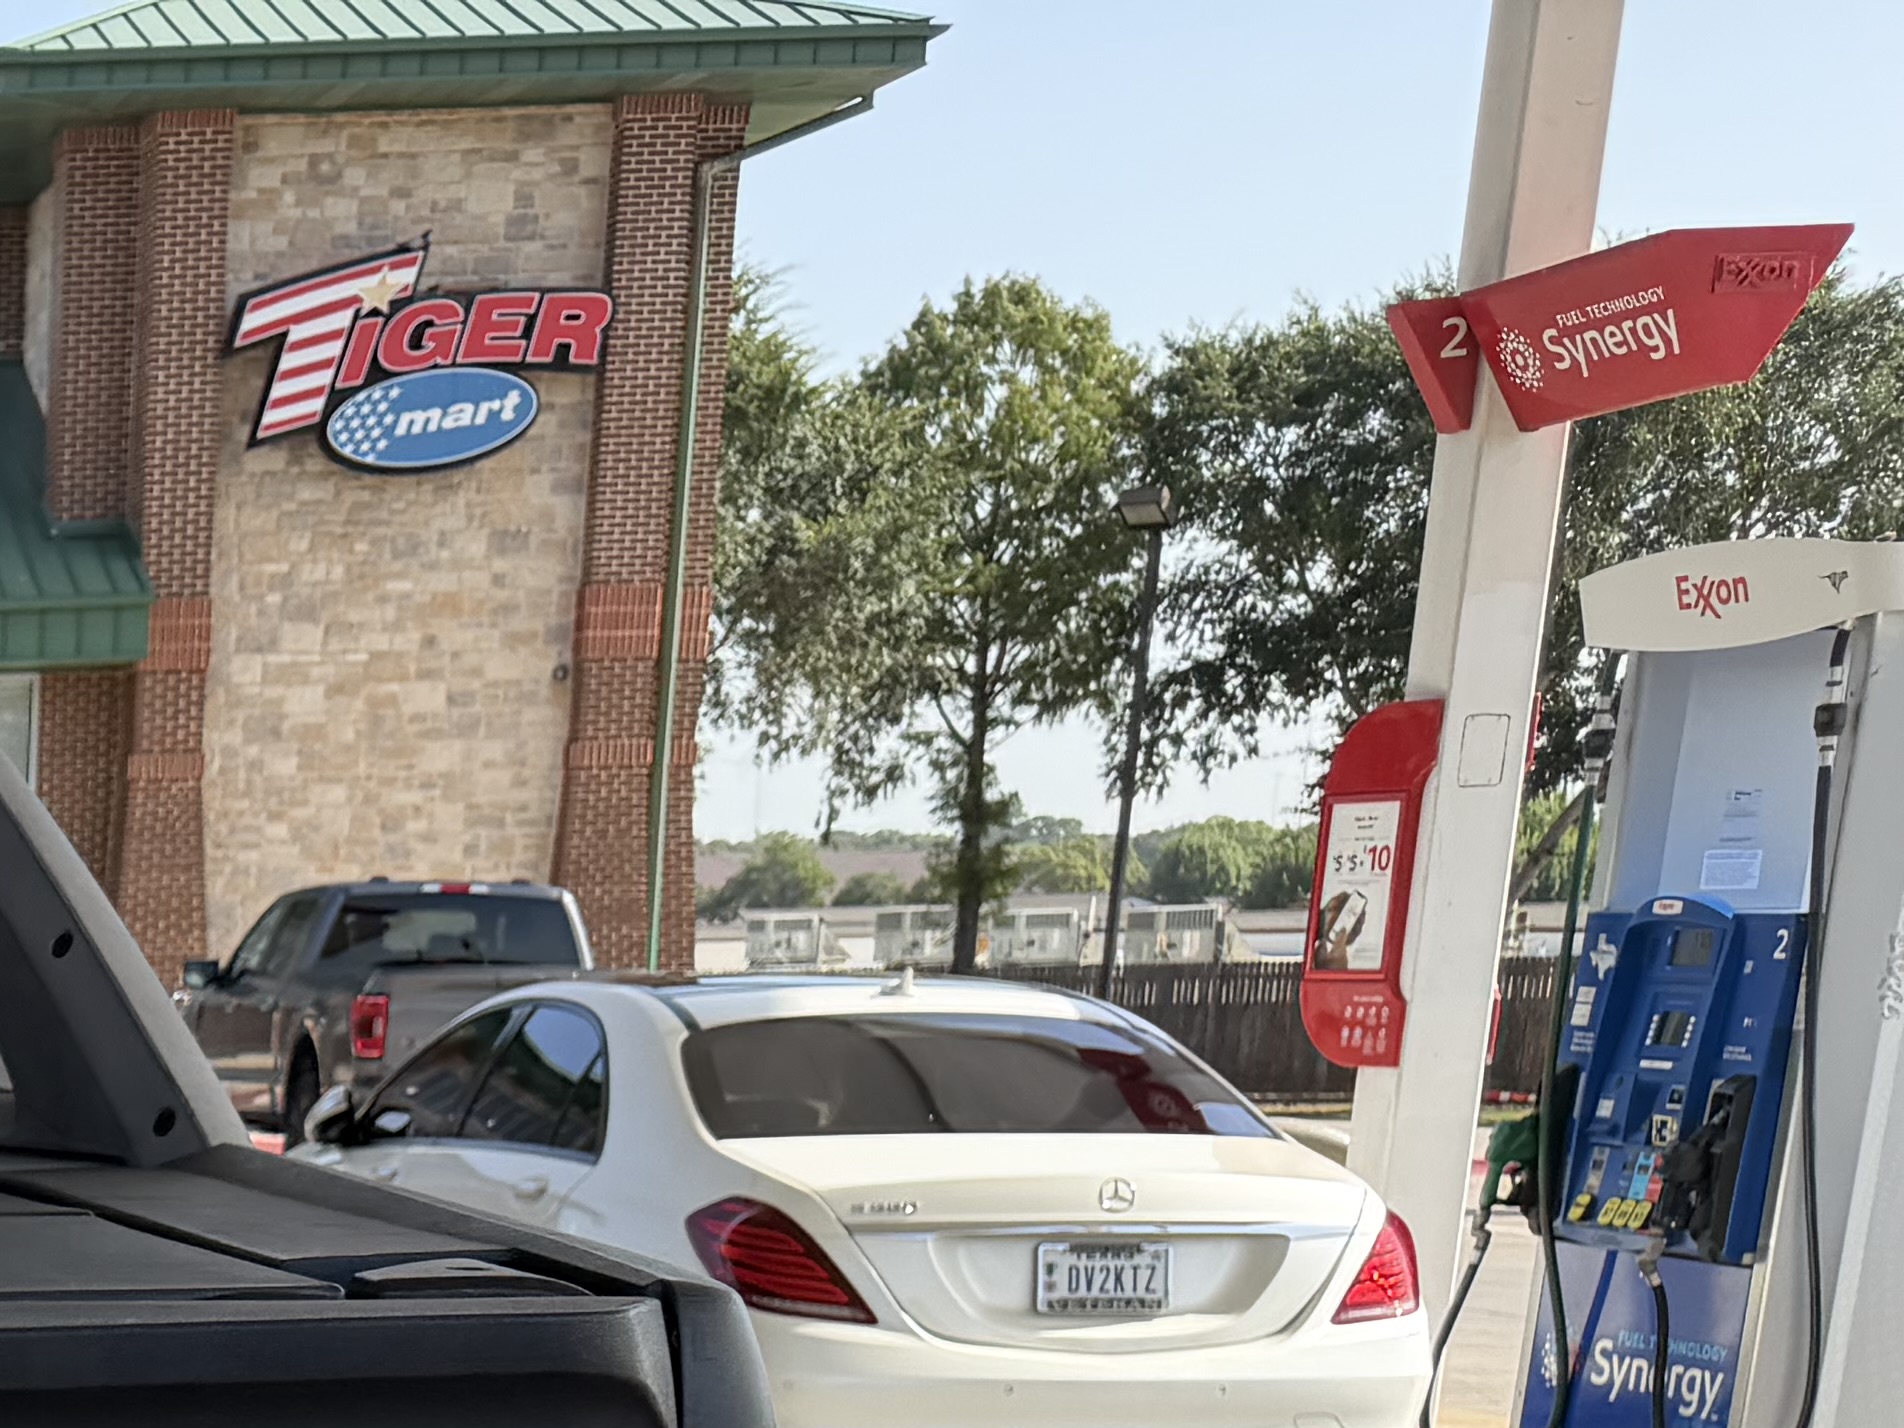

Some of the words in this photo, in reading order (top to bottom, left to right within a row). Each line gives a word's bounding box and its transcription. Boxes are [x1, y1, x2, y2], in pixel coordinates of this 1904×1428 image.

[1556, 308, 1588, 328] FUEL
[1586, 286, 1665, 320] TECHNOLOGY
[234, 250, 614, 440] TIGER
[1440, 316, 1468, 358] 2
[1543, 309, 1681, 378] Synergy
[394, 389, 522, 437] mart
[1675, 575, 1749, 619] Exxon
[1773, 928, 1790, 960] 2
[1068, 1264, 1156, 1294] DV2KTZ
[1648, 1334, 1728, 1364] THNOLOGY
